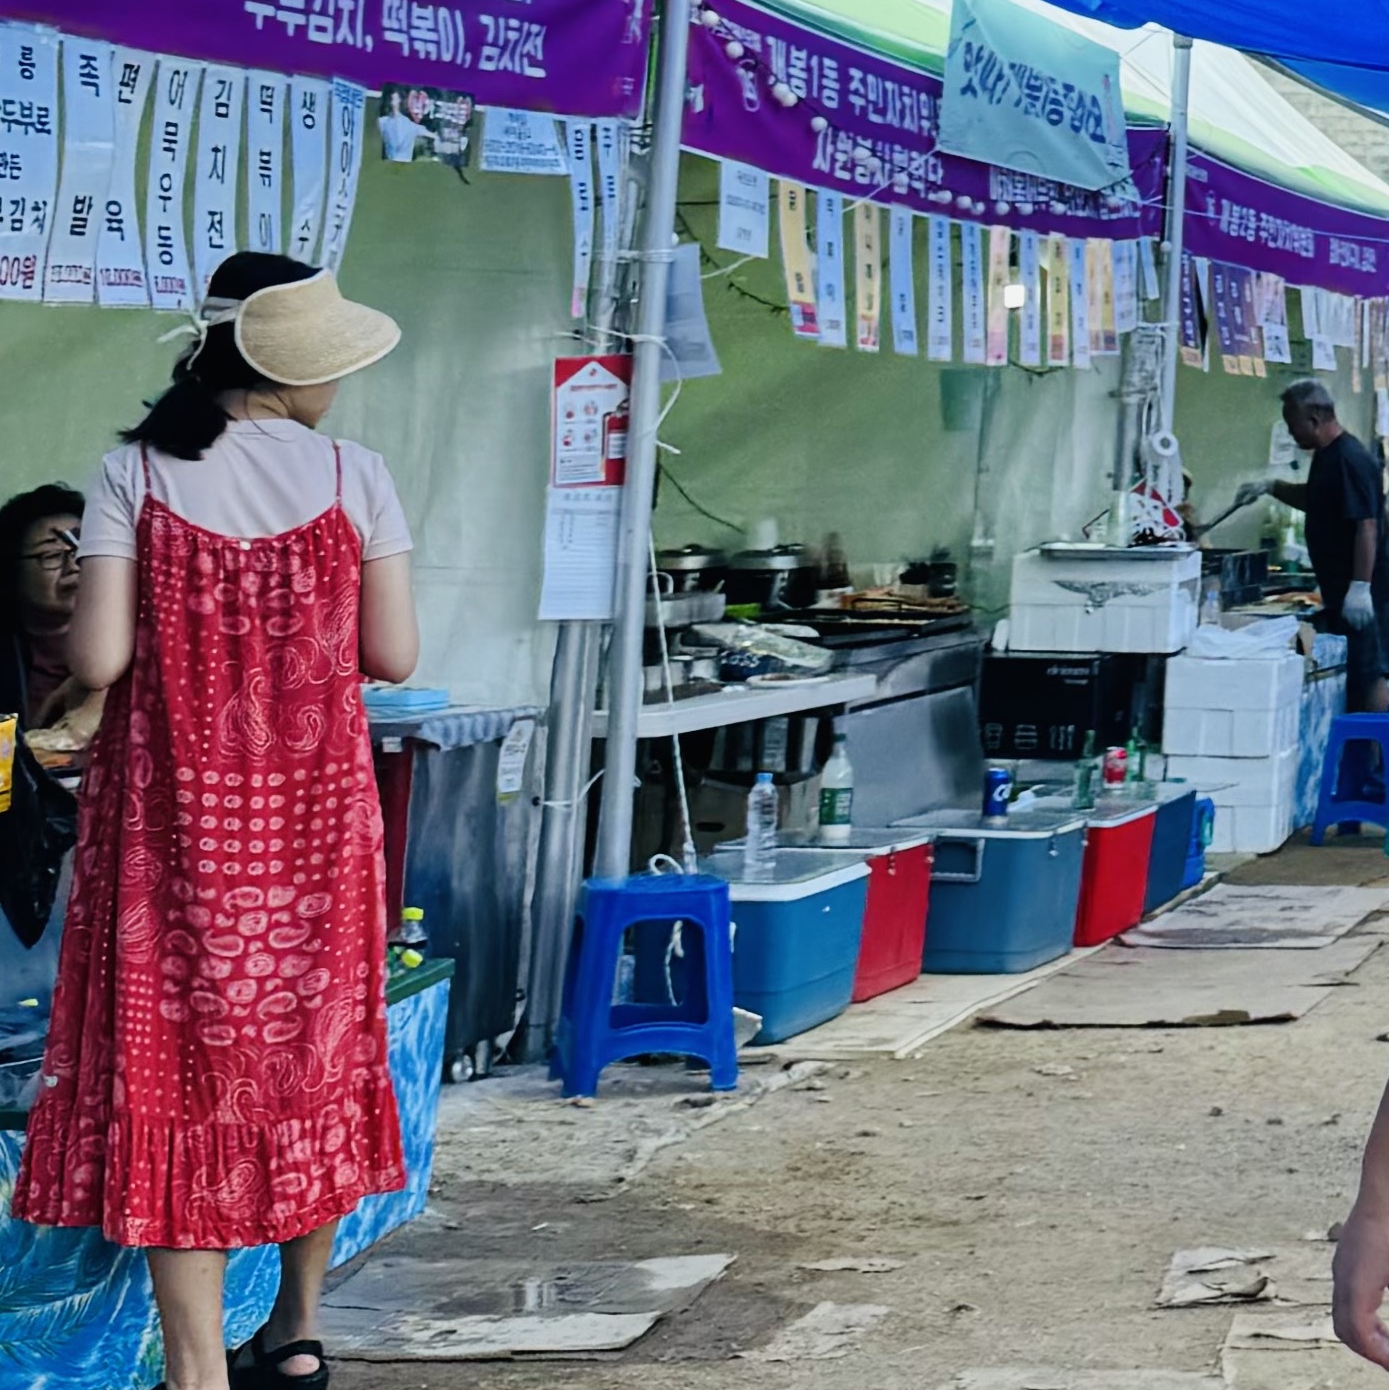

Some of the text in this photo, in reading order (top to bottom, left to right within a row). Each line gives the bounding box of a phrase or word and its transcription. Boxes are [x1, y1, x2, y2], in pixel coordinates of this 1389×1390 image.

[478, 14, 547, 78] 김치전
[765, 36, 841, 108] 개봉1동
[848, 67, 941, 137] 주민자치위
[69, 54, 100, 237] 족발
[104, 63, 141, 241] 편육
[157, 69, 188, 266] 어묵우동
[206, 79, 233, 249] 김치전
